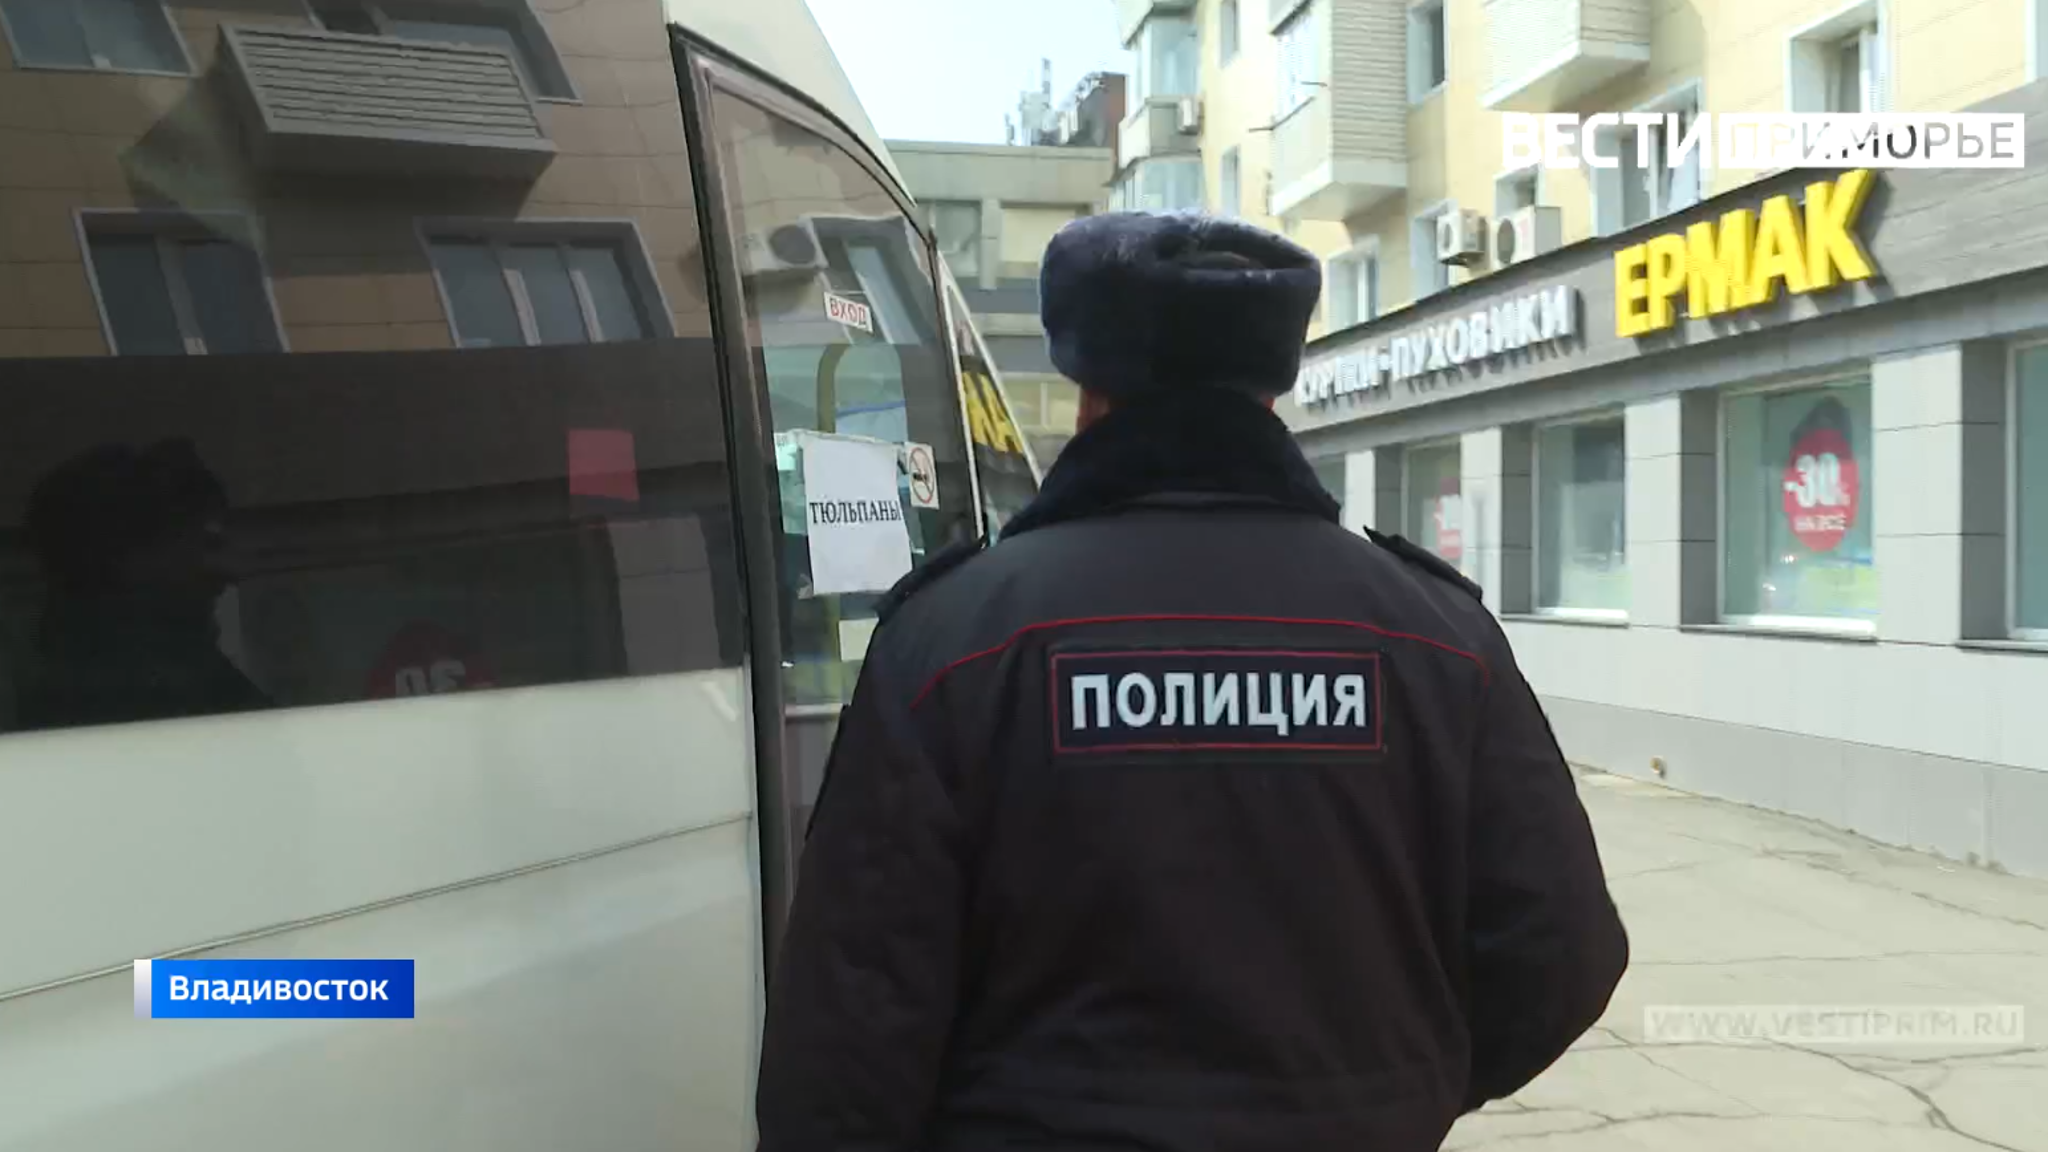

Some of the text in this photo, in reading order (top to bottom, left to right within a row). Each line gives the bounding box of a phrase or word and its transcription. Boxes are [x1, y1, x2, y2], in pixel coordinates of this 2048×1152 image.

[1614, 169, 1876, 337] ЕРМАК
[830, 298, 866, 325] ВХОД
[809, 500, 902, 524] ТЮЛЬПАНЫ
[1071, 672, 1366, 735] ПОЛИЦИЯ
